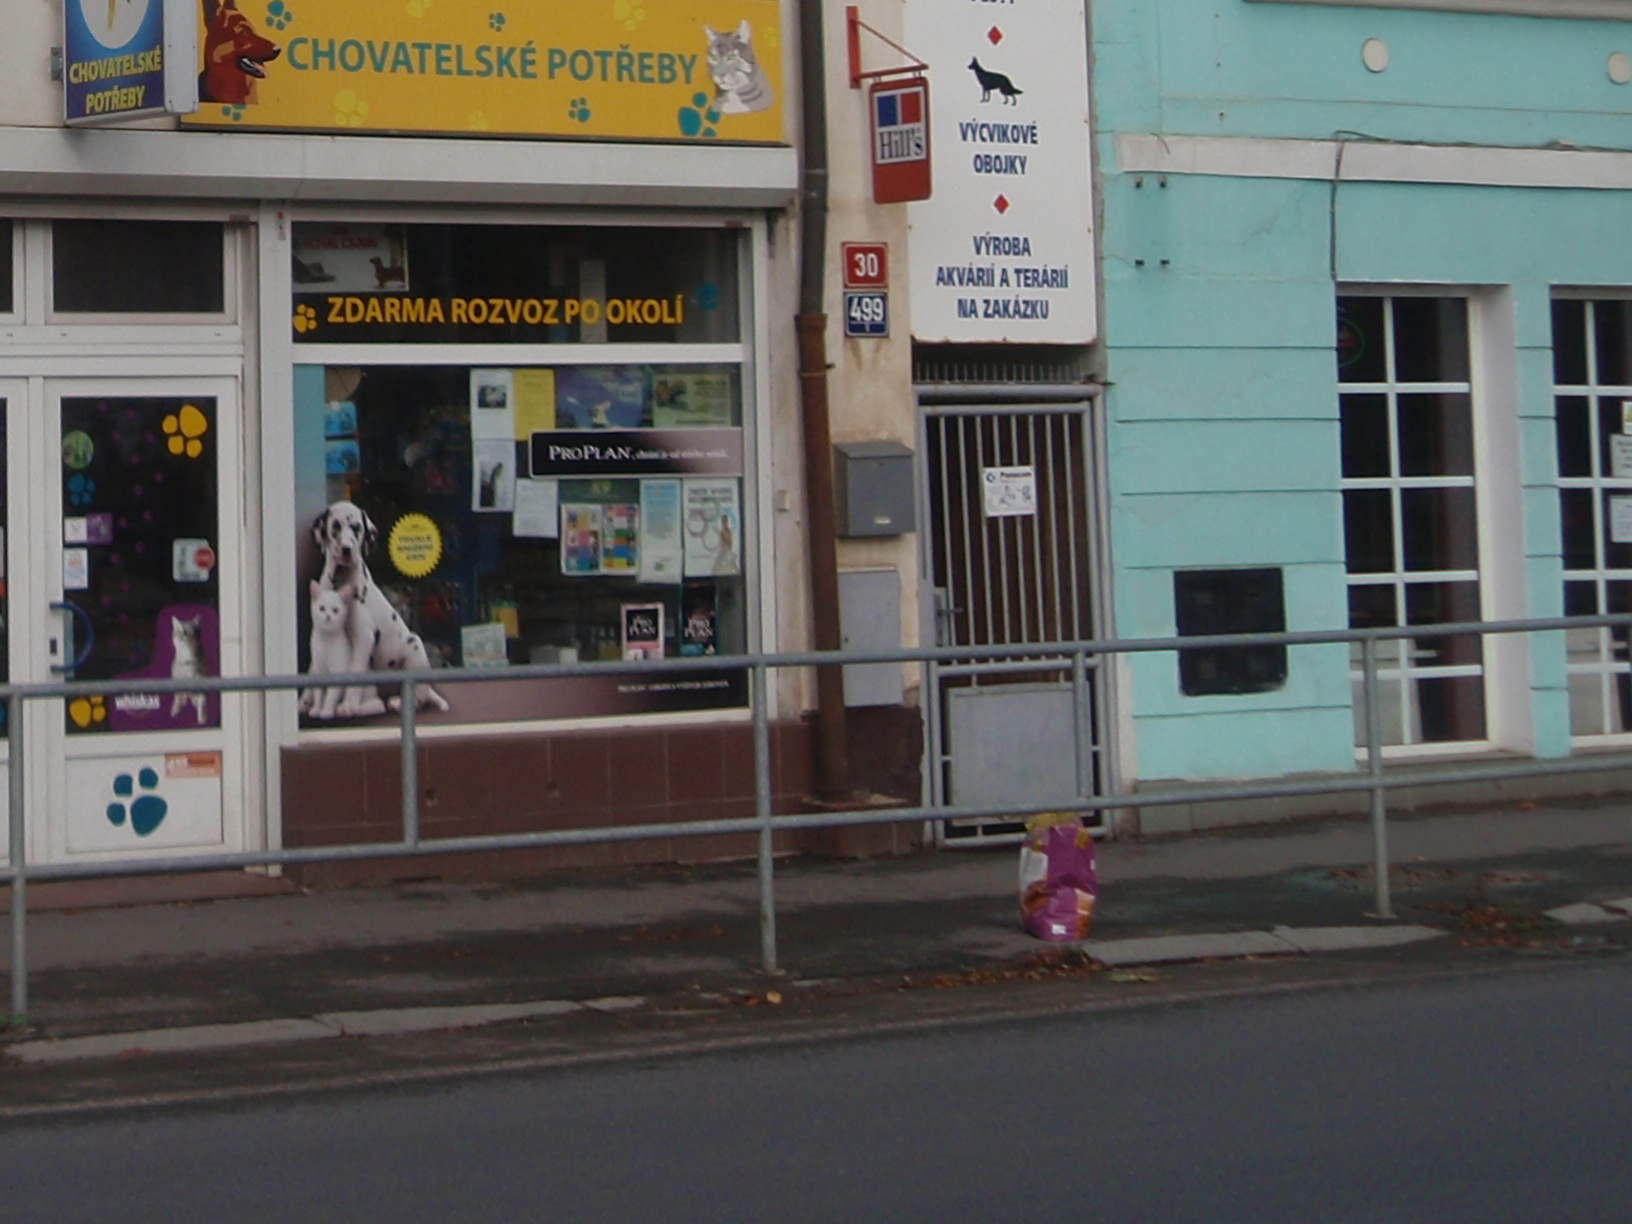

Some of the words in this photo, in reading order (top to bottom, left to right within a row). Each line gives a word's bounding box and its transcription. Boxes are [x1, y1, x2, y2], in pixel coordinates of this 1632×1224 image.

[69, 45, 161, 84] CHOVATELSKÉ
[287, 36, 537, 78] CHOVATELSKÉ
[548, 43, 697, 85] POTŘEBY
[86, 84, 145, 114] POTŘEBY
[879, 128, 923, 160] Hill's
[959, 118, 1038, 145] VÝCVIKOVÉ
[973, 153, 1027, 175] OBOJKY
[973, 231, 1032, 257] VÝROBA
[854, 253, 878, 277] 30
[936, 262, 995, 287] AKVÁRIÍ
[999, 267, 1010, 287] A
[1014, 263, 1068, 288] TERÁRIÍ
[327, 297, 444, 324] ZDARMA
[451, 298, 559, 325] ROZVOZ
[564, 299, 601, 325] PO
[606, 293, 684, 324] OKOLÍ
[851, 297, 883, 321] 499
[957, 298, 978, 318] NA
[982, 294, 1049, 319] ZAKÁZKU
